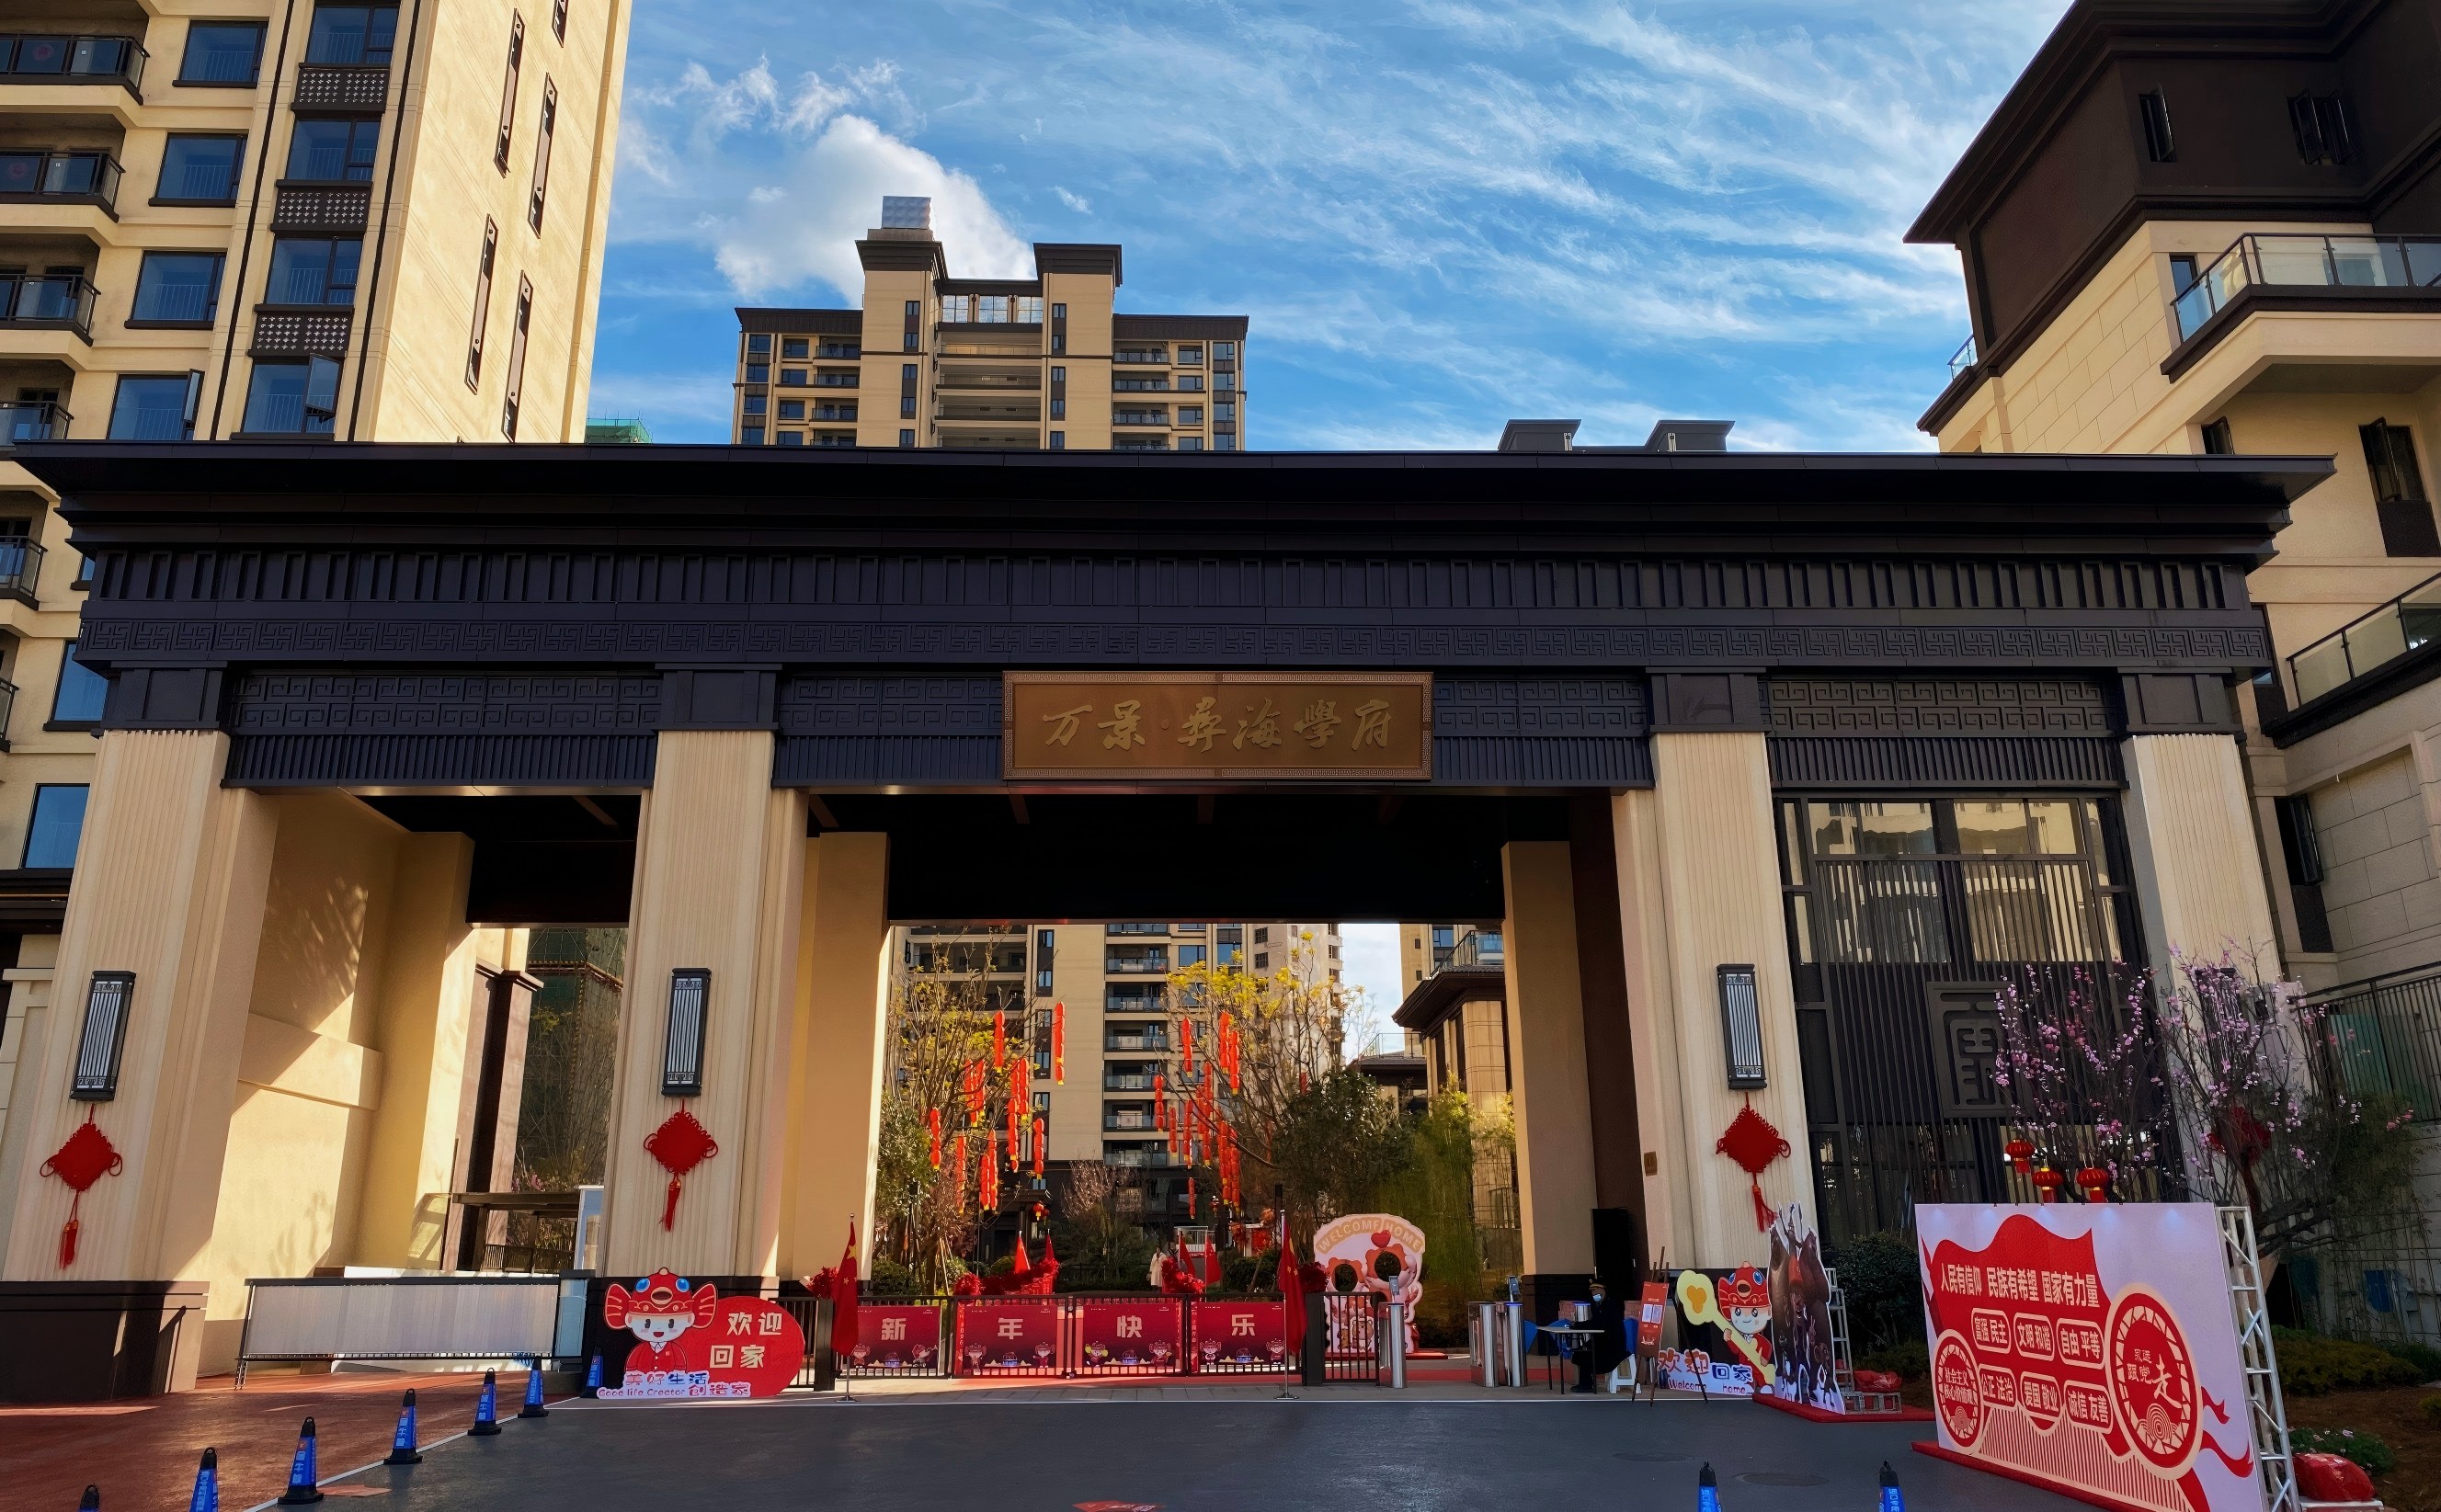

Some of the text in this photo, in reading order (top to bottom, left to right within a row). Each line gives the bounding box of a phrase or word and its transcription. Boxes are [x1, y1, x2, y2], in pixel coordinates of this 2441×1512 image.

[1318, 1220, 1421, 1251] WELCOME HOME
[1941, 1263, 2100, 1308] 人民有信仰 民族有希望 国家有力量
[727, 1312, 781, 1336] 欢迎
[881, 1313, 1256, 1341] 新 年 快 乐
[1974, 1316, 2009, 1345] 富强 民主
[2017, 1322, 2052, 1351] 文明 和谐
[710, 1345, 766, 1369] 回家
[2060, 1328, 2101, 1359] 自由 平等
[626, 1373, 707, 1385] 美好生活
[1659, 1347, 1751, 1384] 欢迎 回家
[1945, 1367, 1968, 1386] 社会主义
[599, 1388, 686, 1397] Good life Creator
[689, 1384, 750, 1396] 创造家
[1669, 1379, 1746, 1394] Welcome home
[1980, 1373, 2014, 1404] 公正 法治
[2151, 1354, 2183, 1408] 走
[2024, 1381, 2059, 1412] 爱国 敬业
[2068, 1390, 2109, 1424] 诚信 友善
